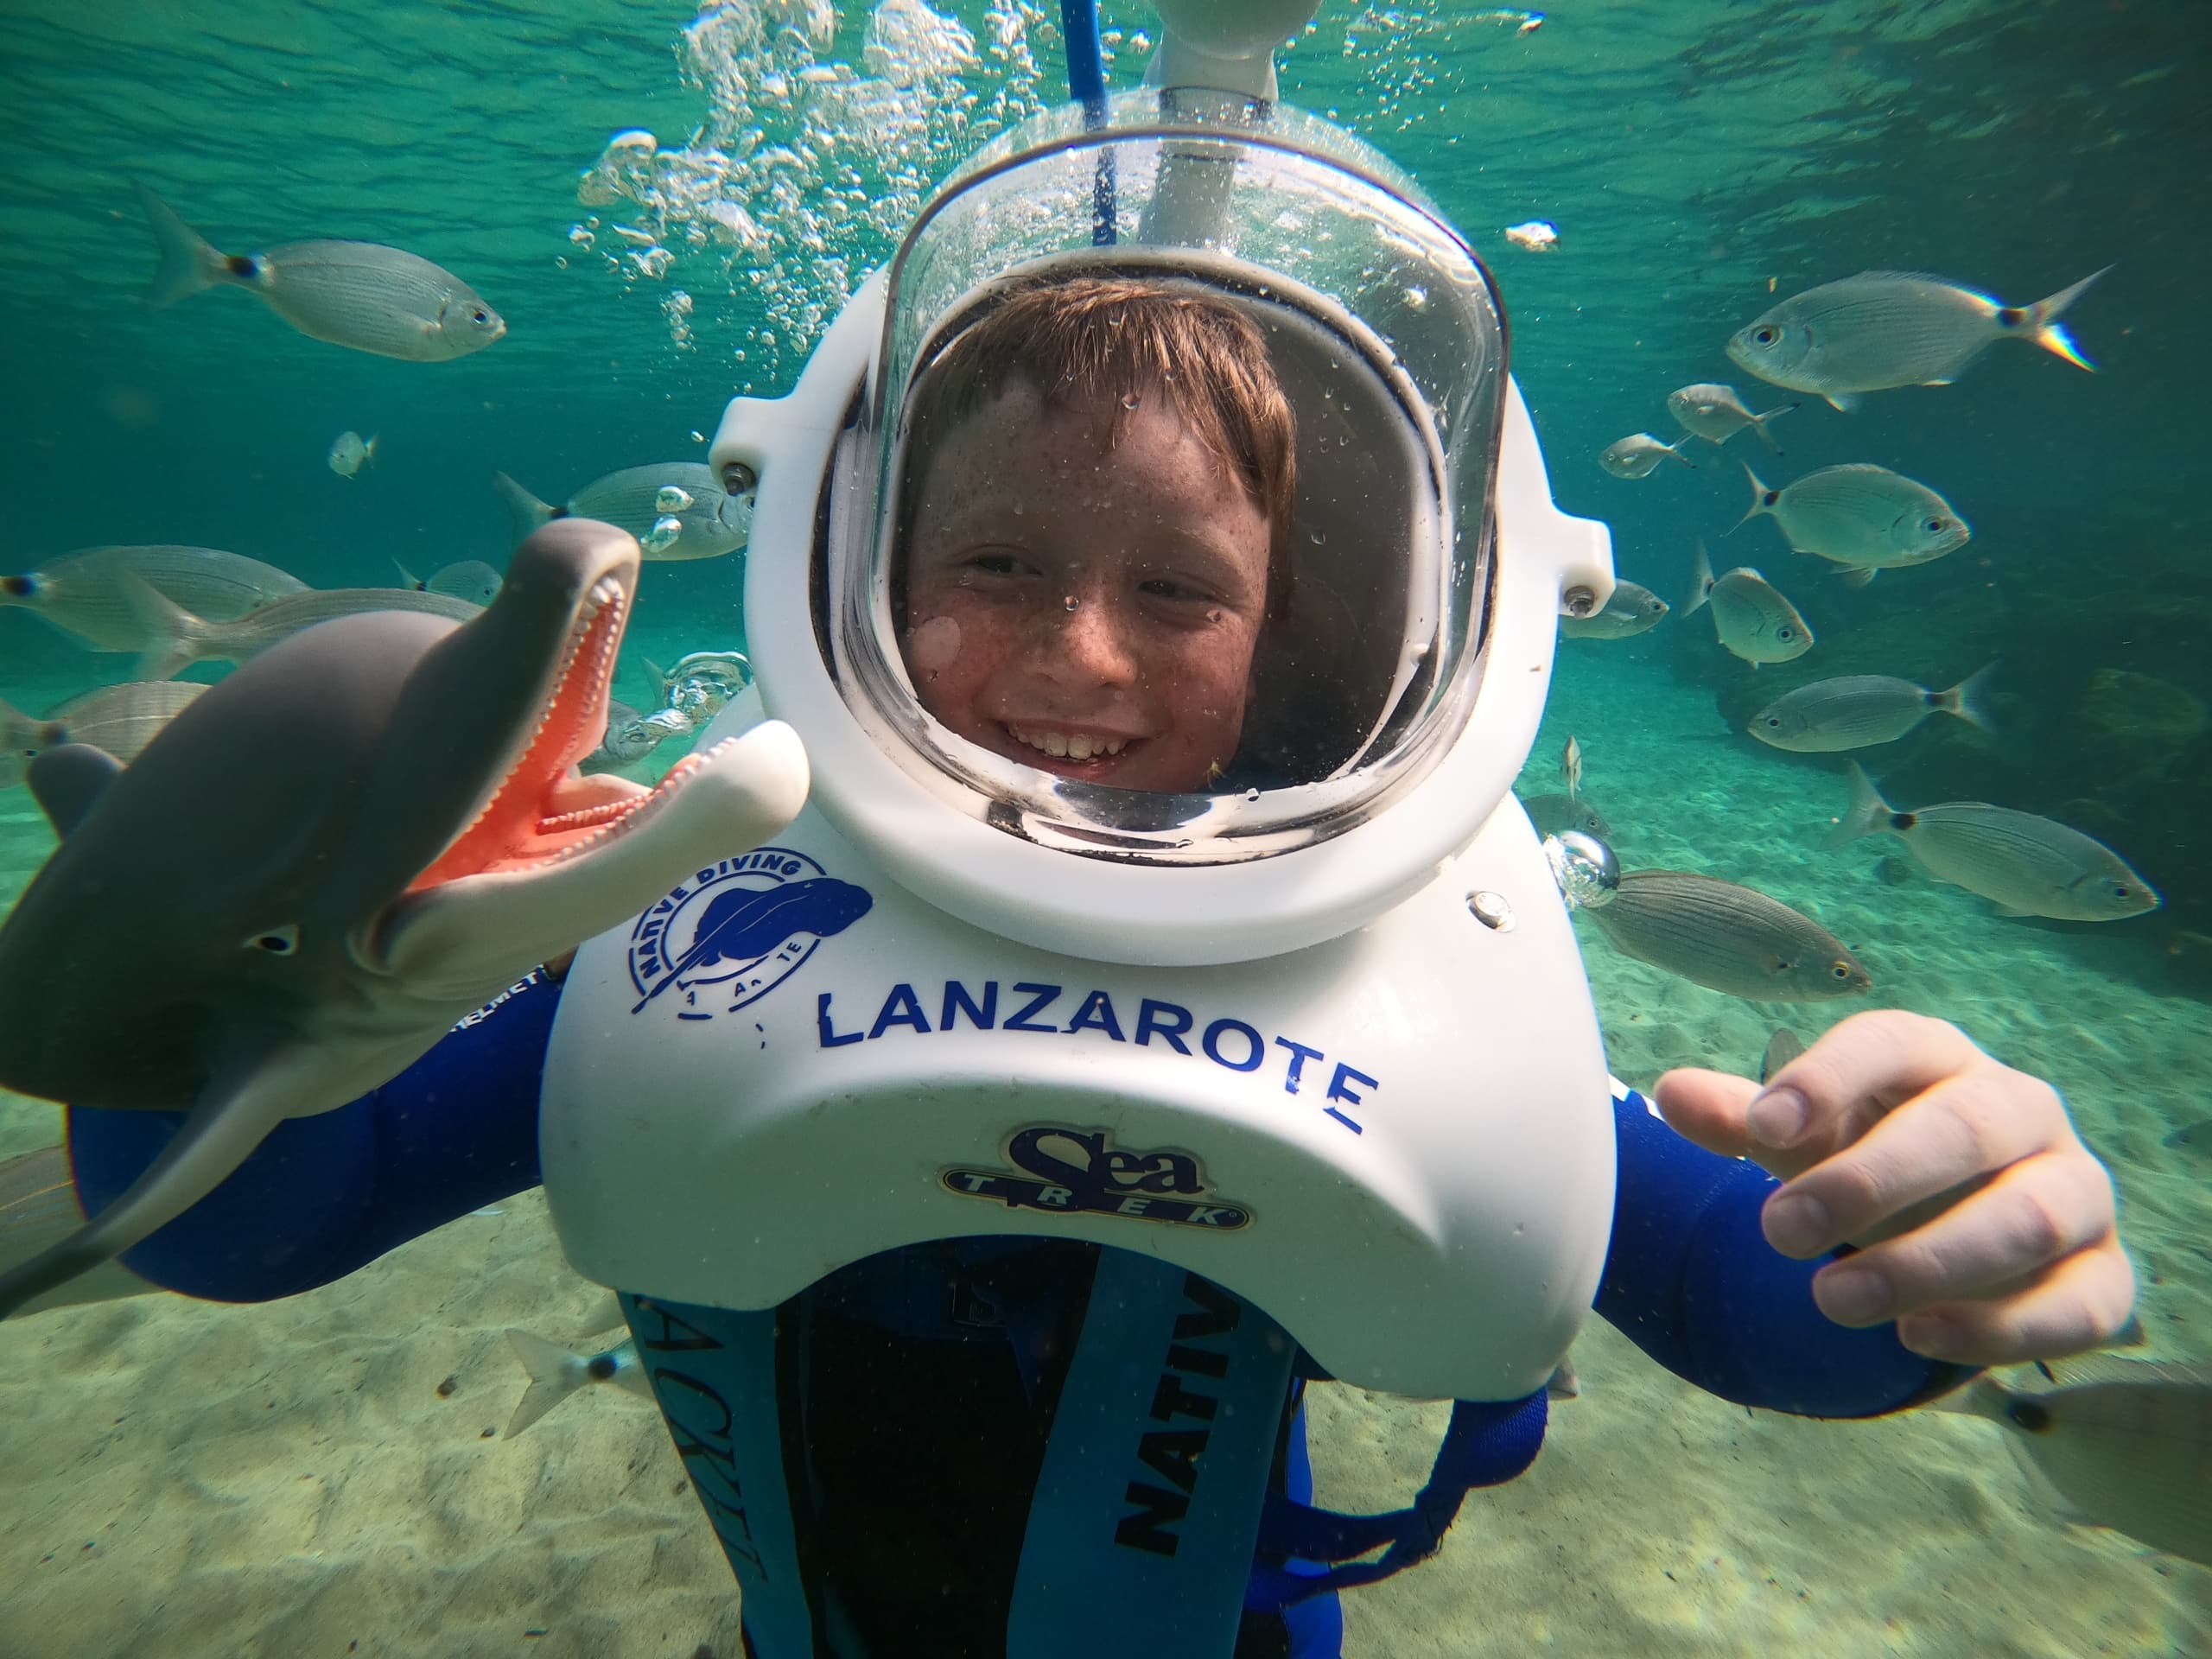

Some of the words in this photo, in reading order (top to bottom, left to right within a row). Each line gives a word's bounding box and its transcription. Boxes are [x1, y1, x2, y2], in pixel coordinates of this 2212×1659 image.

[639, 887, 690, 979] NATIVE
[696, 854, 802, 884] DIVING
[817, 980, 1379, 1136] LANZAROTE
[963, 1173, 1225, 1226] TREK
[1008, 1127, 1205, 1210] Sea
